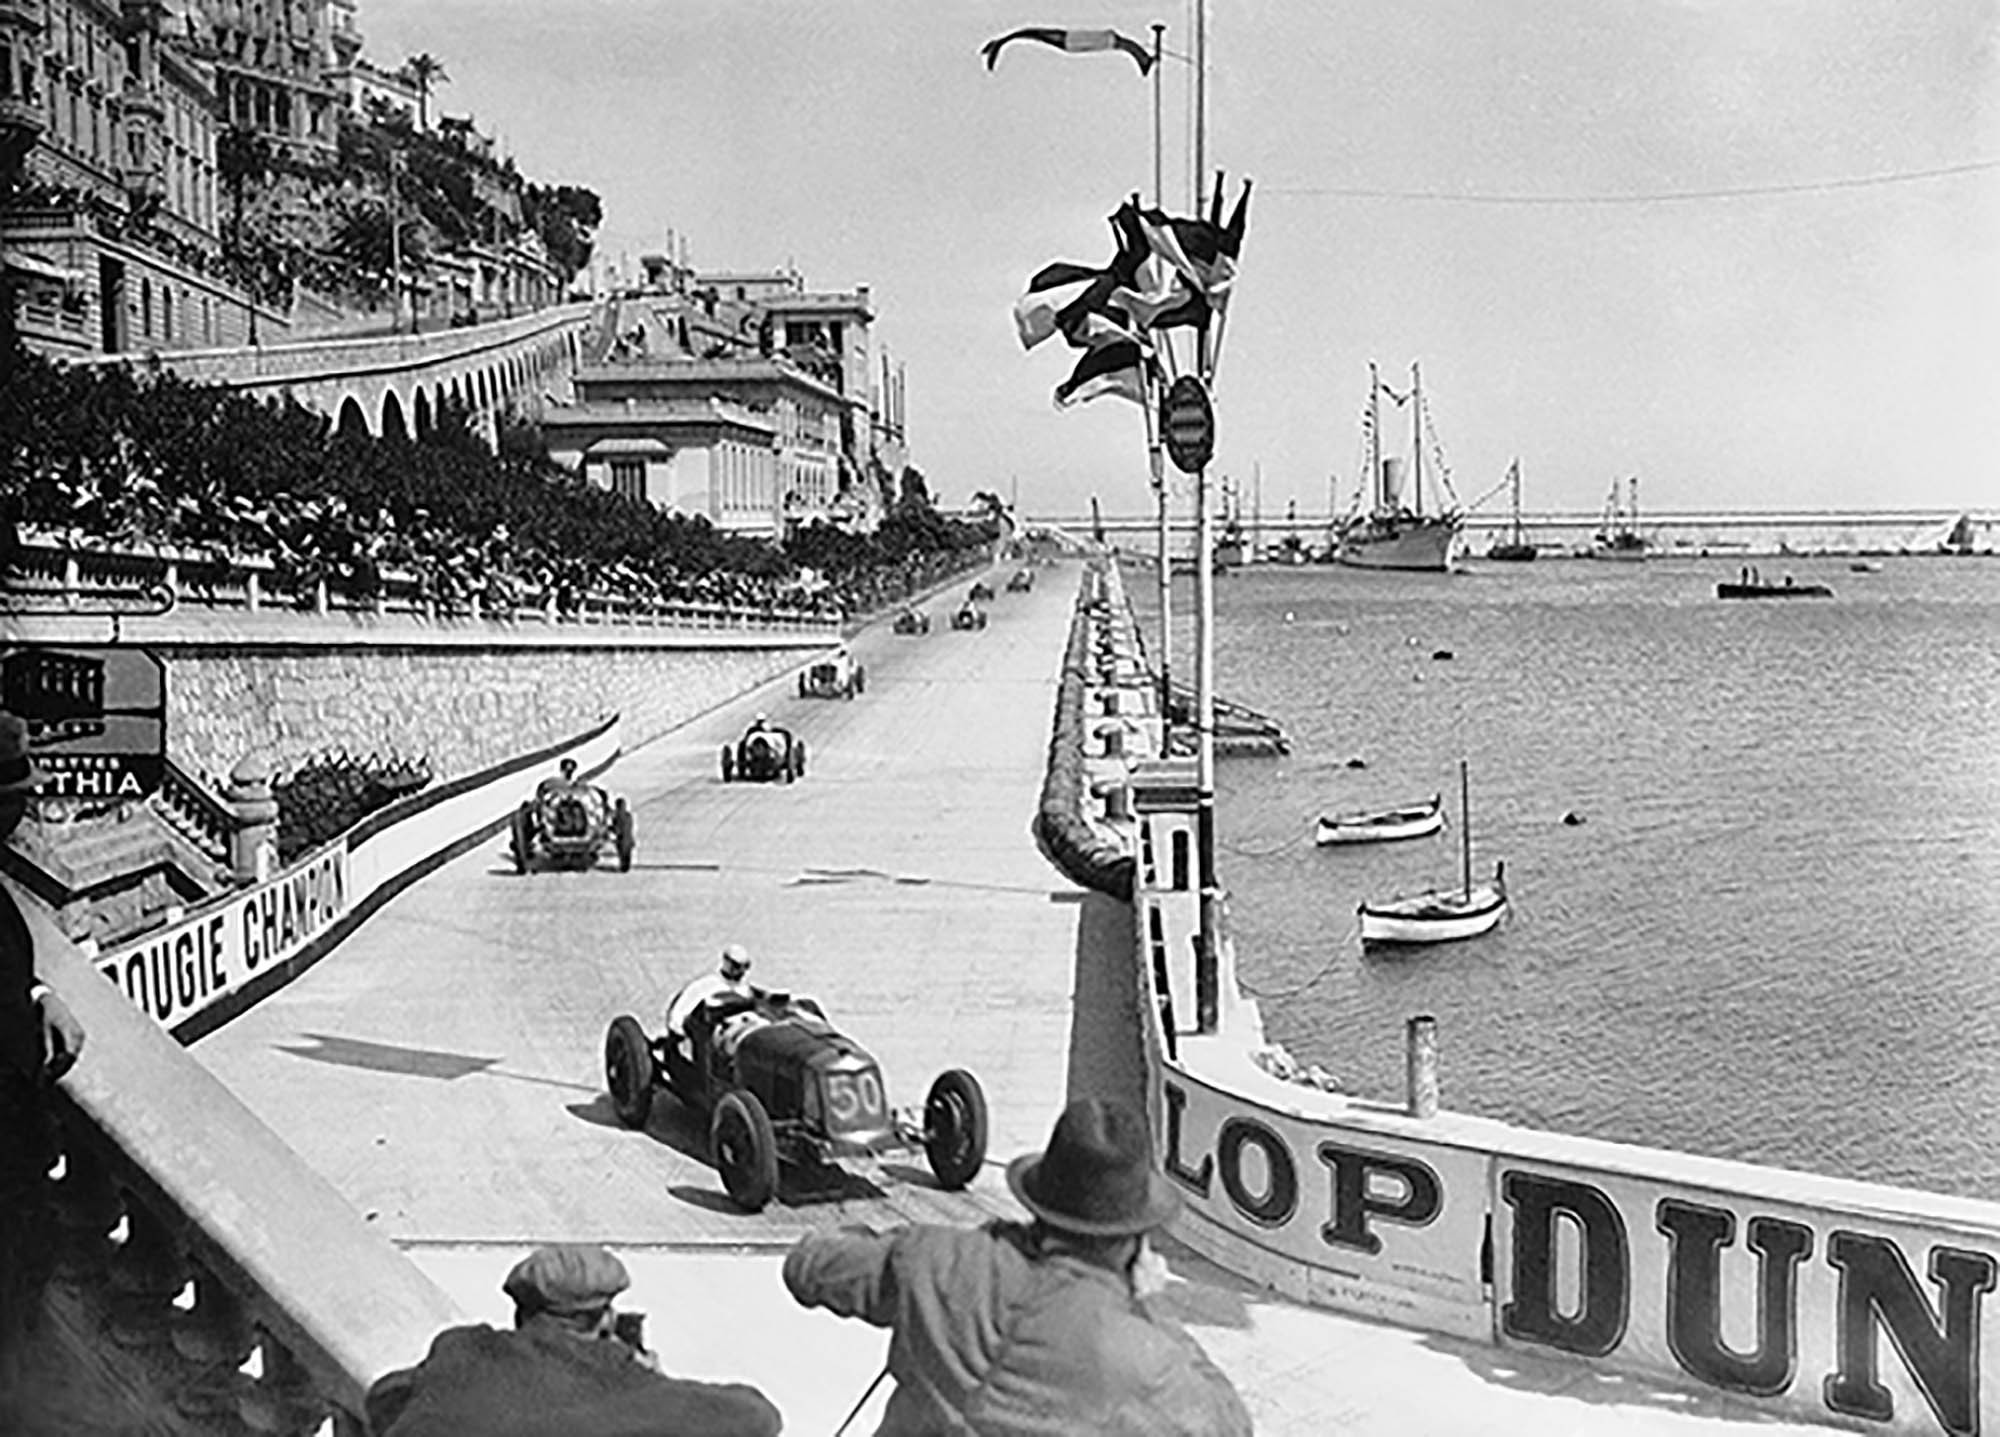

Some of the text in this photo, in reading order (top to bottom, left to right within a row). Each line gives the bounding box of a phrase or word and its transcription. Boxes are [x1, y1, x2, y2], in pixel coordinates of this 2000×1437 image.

[33, 771, 143, 795] THIA
[828, 1073, 880, 1120] 50
[1501, 1166, 1998, 1437] DUN
